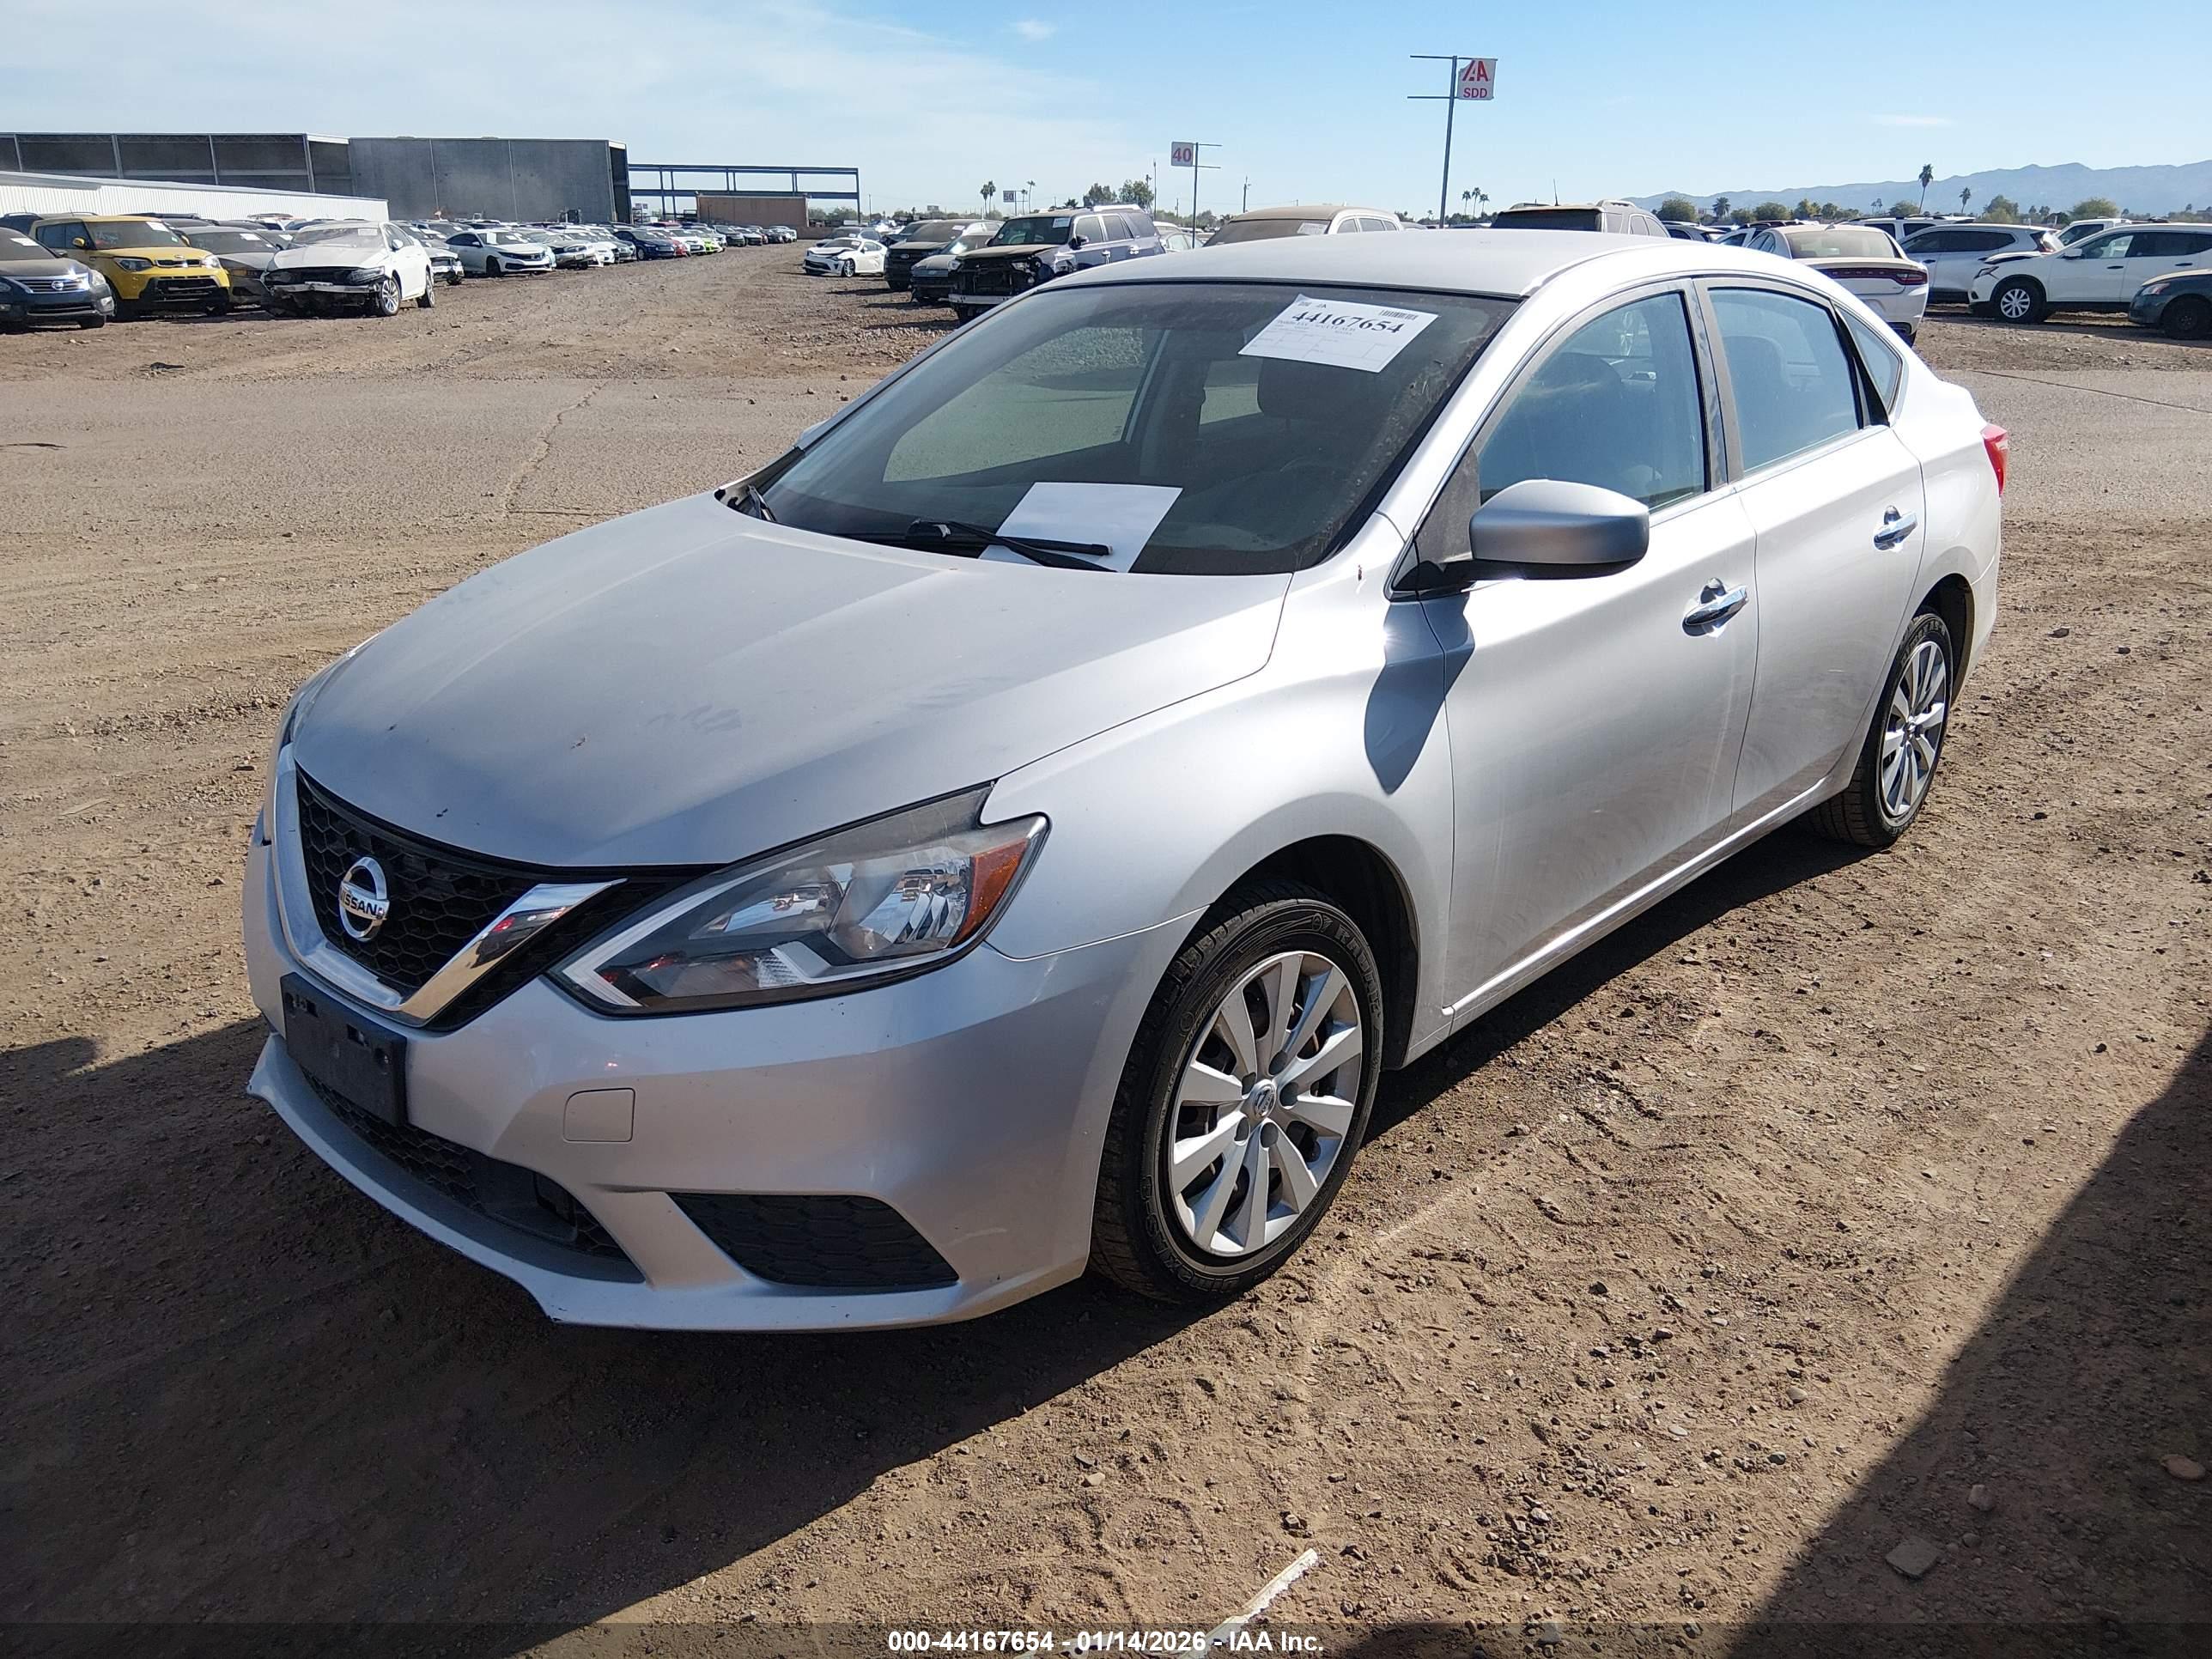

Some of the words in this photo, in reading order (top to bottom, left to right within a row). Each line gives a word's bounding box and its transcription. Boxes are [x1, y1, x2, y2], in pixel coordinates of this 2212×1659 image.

[1463, 88, 1488, 99] SDD
[1172, 148, 1192, 162] 40
[1291, 311, 1404, 333] 44167654
